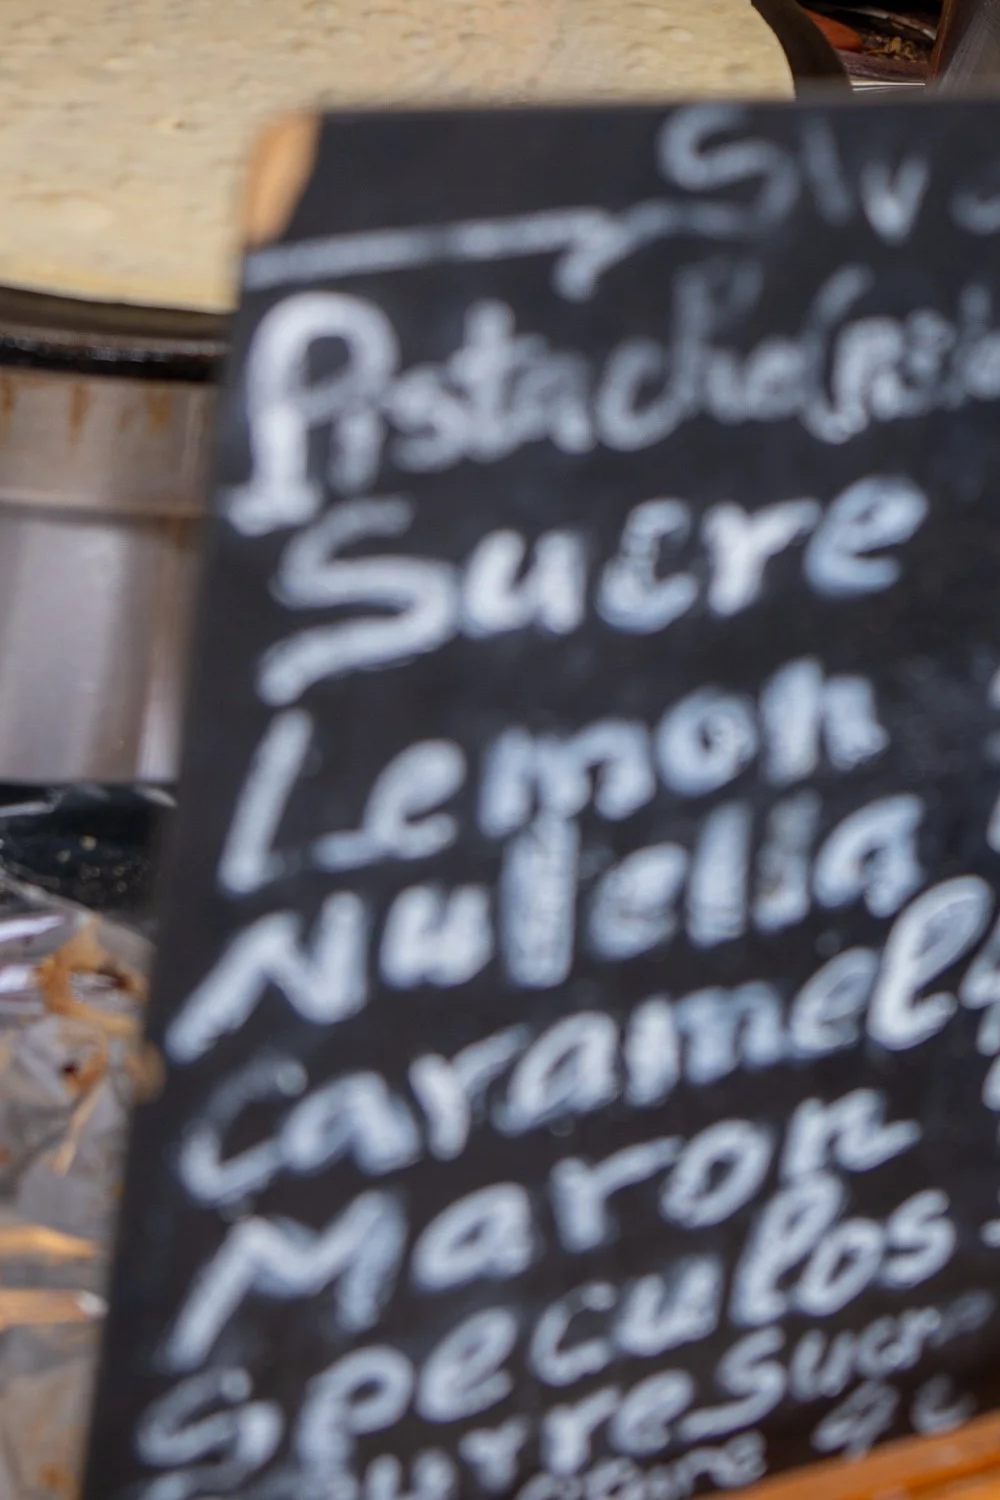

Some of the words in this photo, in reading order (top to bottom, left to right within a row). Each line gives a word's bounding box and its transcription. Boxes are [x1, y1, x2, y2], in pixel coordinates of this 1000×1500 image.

[257, 475, 930, 706] Sucre
[215, 655, 890, 895] Lemon
[178, 874, 994, 1202] Caramel
